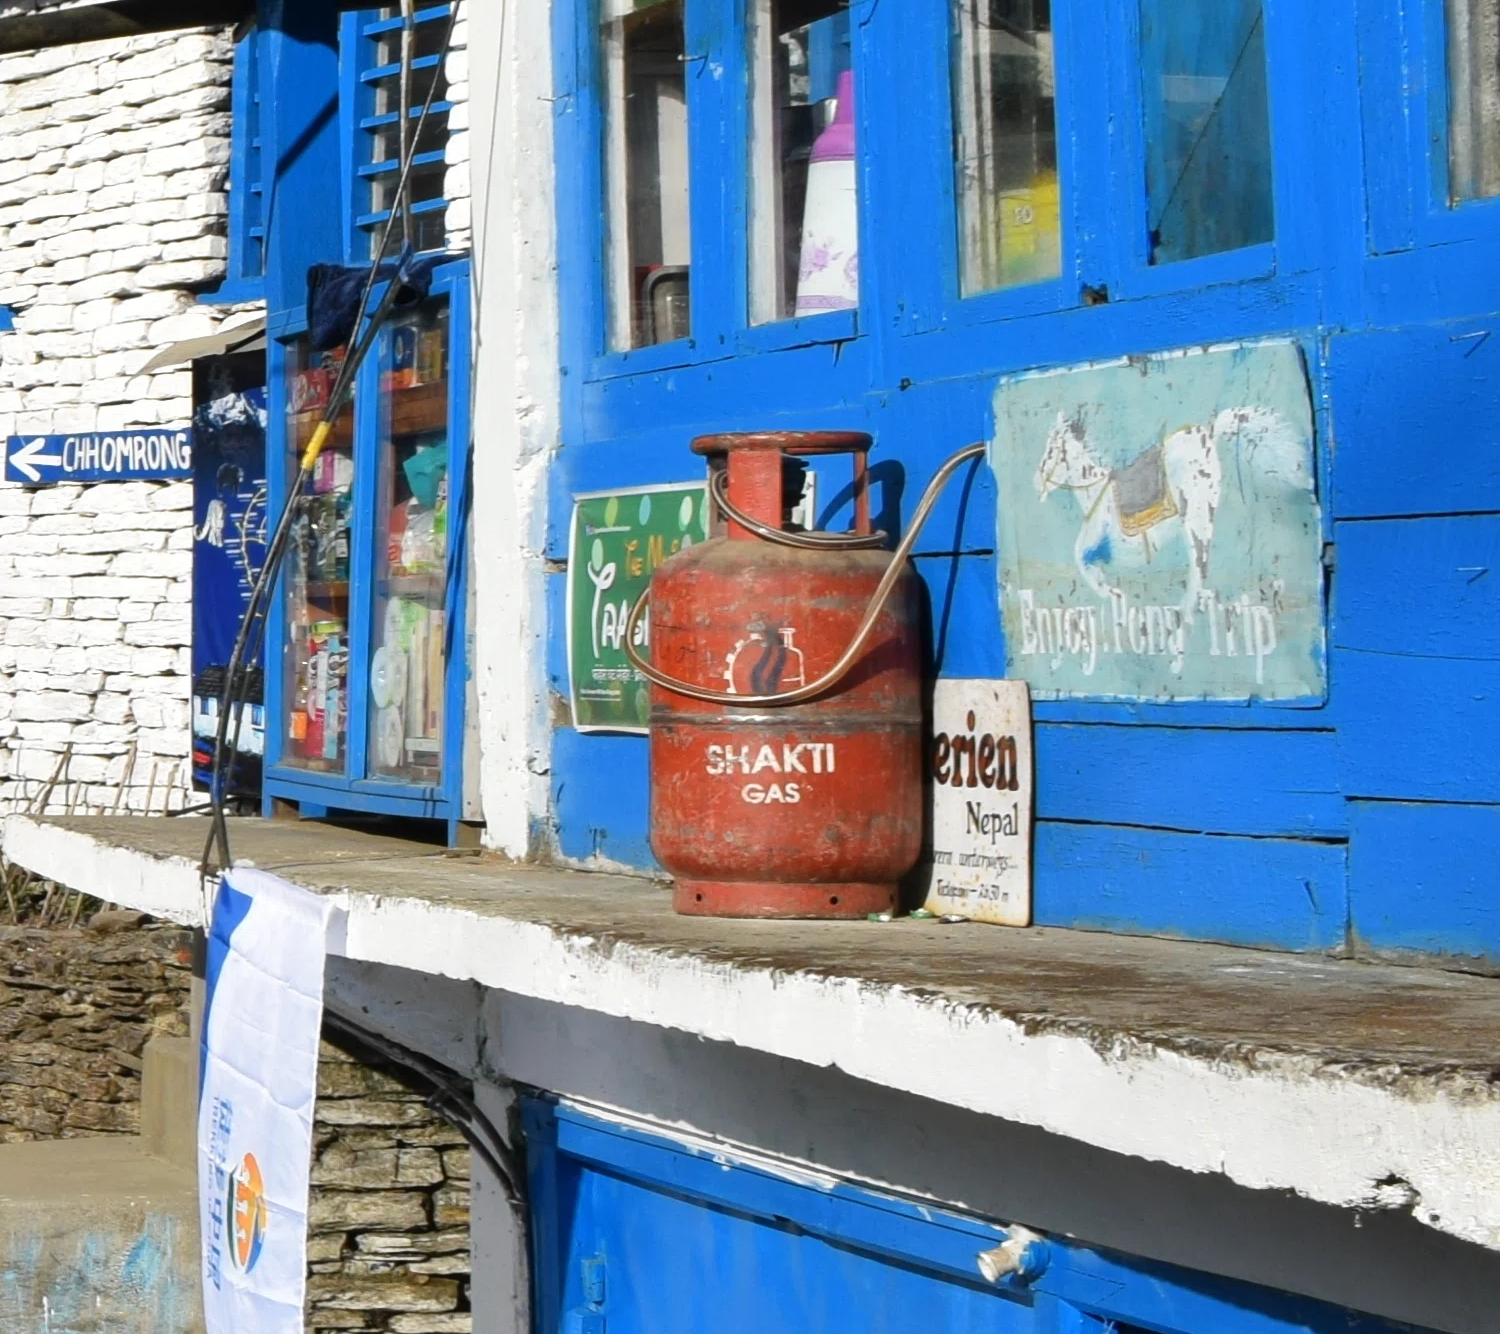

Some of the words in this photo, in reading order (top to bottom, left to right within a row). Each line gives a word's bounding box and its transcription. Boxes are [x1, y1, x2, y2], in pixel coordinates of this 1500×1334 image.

[63, 433, 191, 472] CHHOMRONG
[1017, 589, 1097, 675] Enjoy
[1109, 588, 1190, 674] Pony
[1199, 589, 1277, 684] Trip
[704, 743, 835, 775] SHAKTI
[741, 782, 801, 804] GAS
[966, 801, 1018, 845] Nepal
